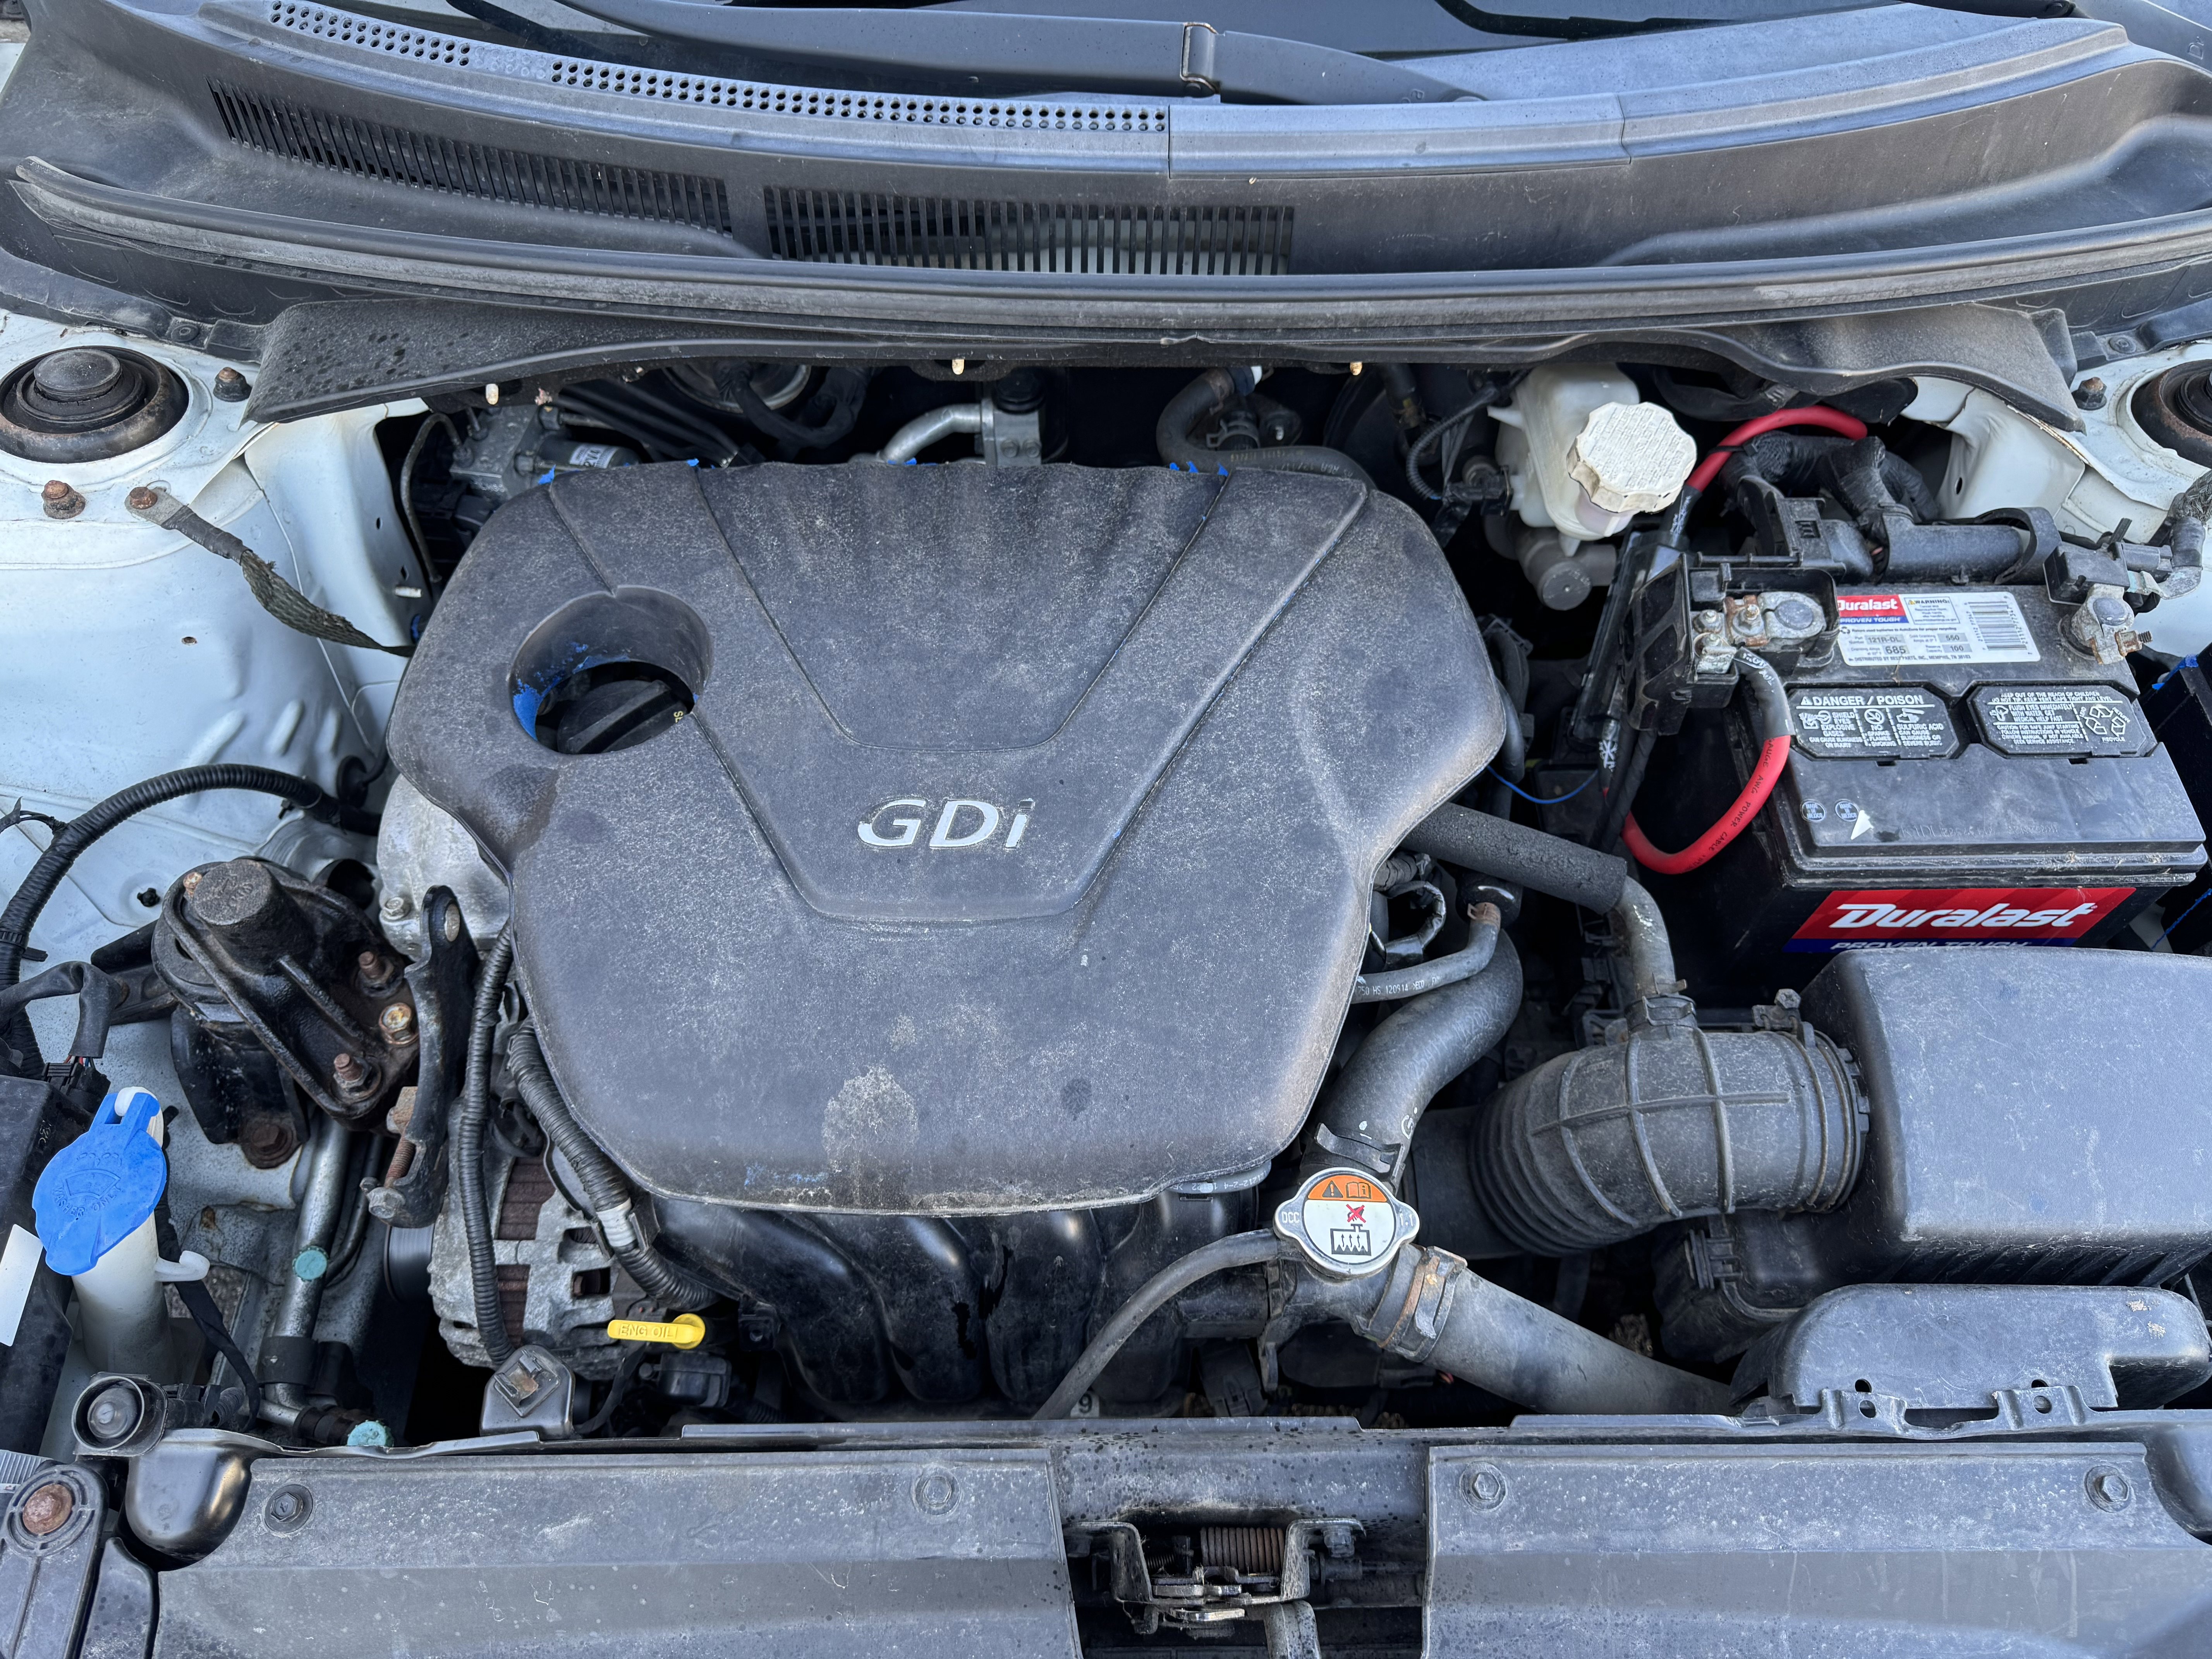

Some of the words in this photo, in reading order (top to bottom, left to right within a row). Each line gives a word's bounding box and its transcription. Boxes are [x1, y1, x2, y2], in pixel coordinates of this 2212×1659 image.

[1838, 598, 1898, 611] Duralast
[1812, 696, 1865, 706] DANGER
[1877, 695, 1924, 705] POISON
[2112, 707, 2131, 723] RETURN
[1752, 775, 1764, 794] AWG
[1731, 801, 1751, 827] POWER
[857, 798, 1036, 849] GDi
[1709, 832, 1728, 851] CABLE
[1829, 903, 2096, 928] Duralast
[1373, 985, 1381, 995] HS
[53, 1184, 85, 1217] WASHER
[93, 1184, 121, 1212] ONLY
[1281, 1211, 1300, 1224] DCC
[1399, 1214, 1413, 1226] 1.1
[619, 1323, 647, 1336] ENG
[652, 1326, 673, 1338] OIL
